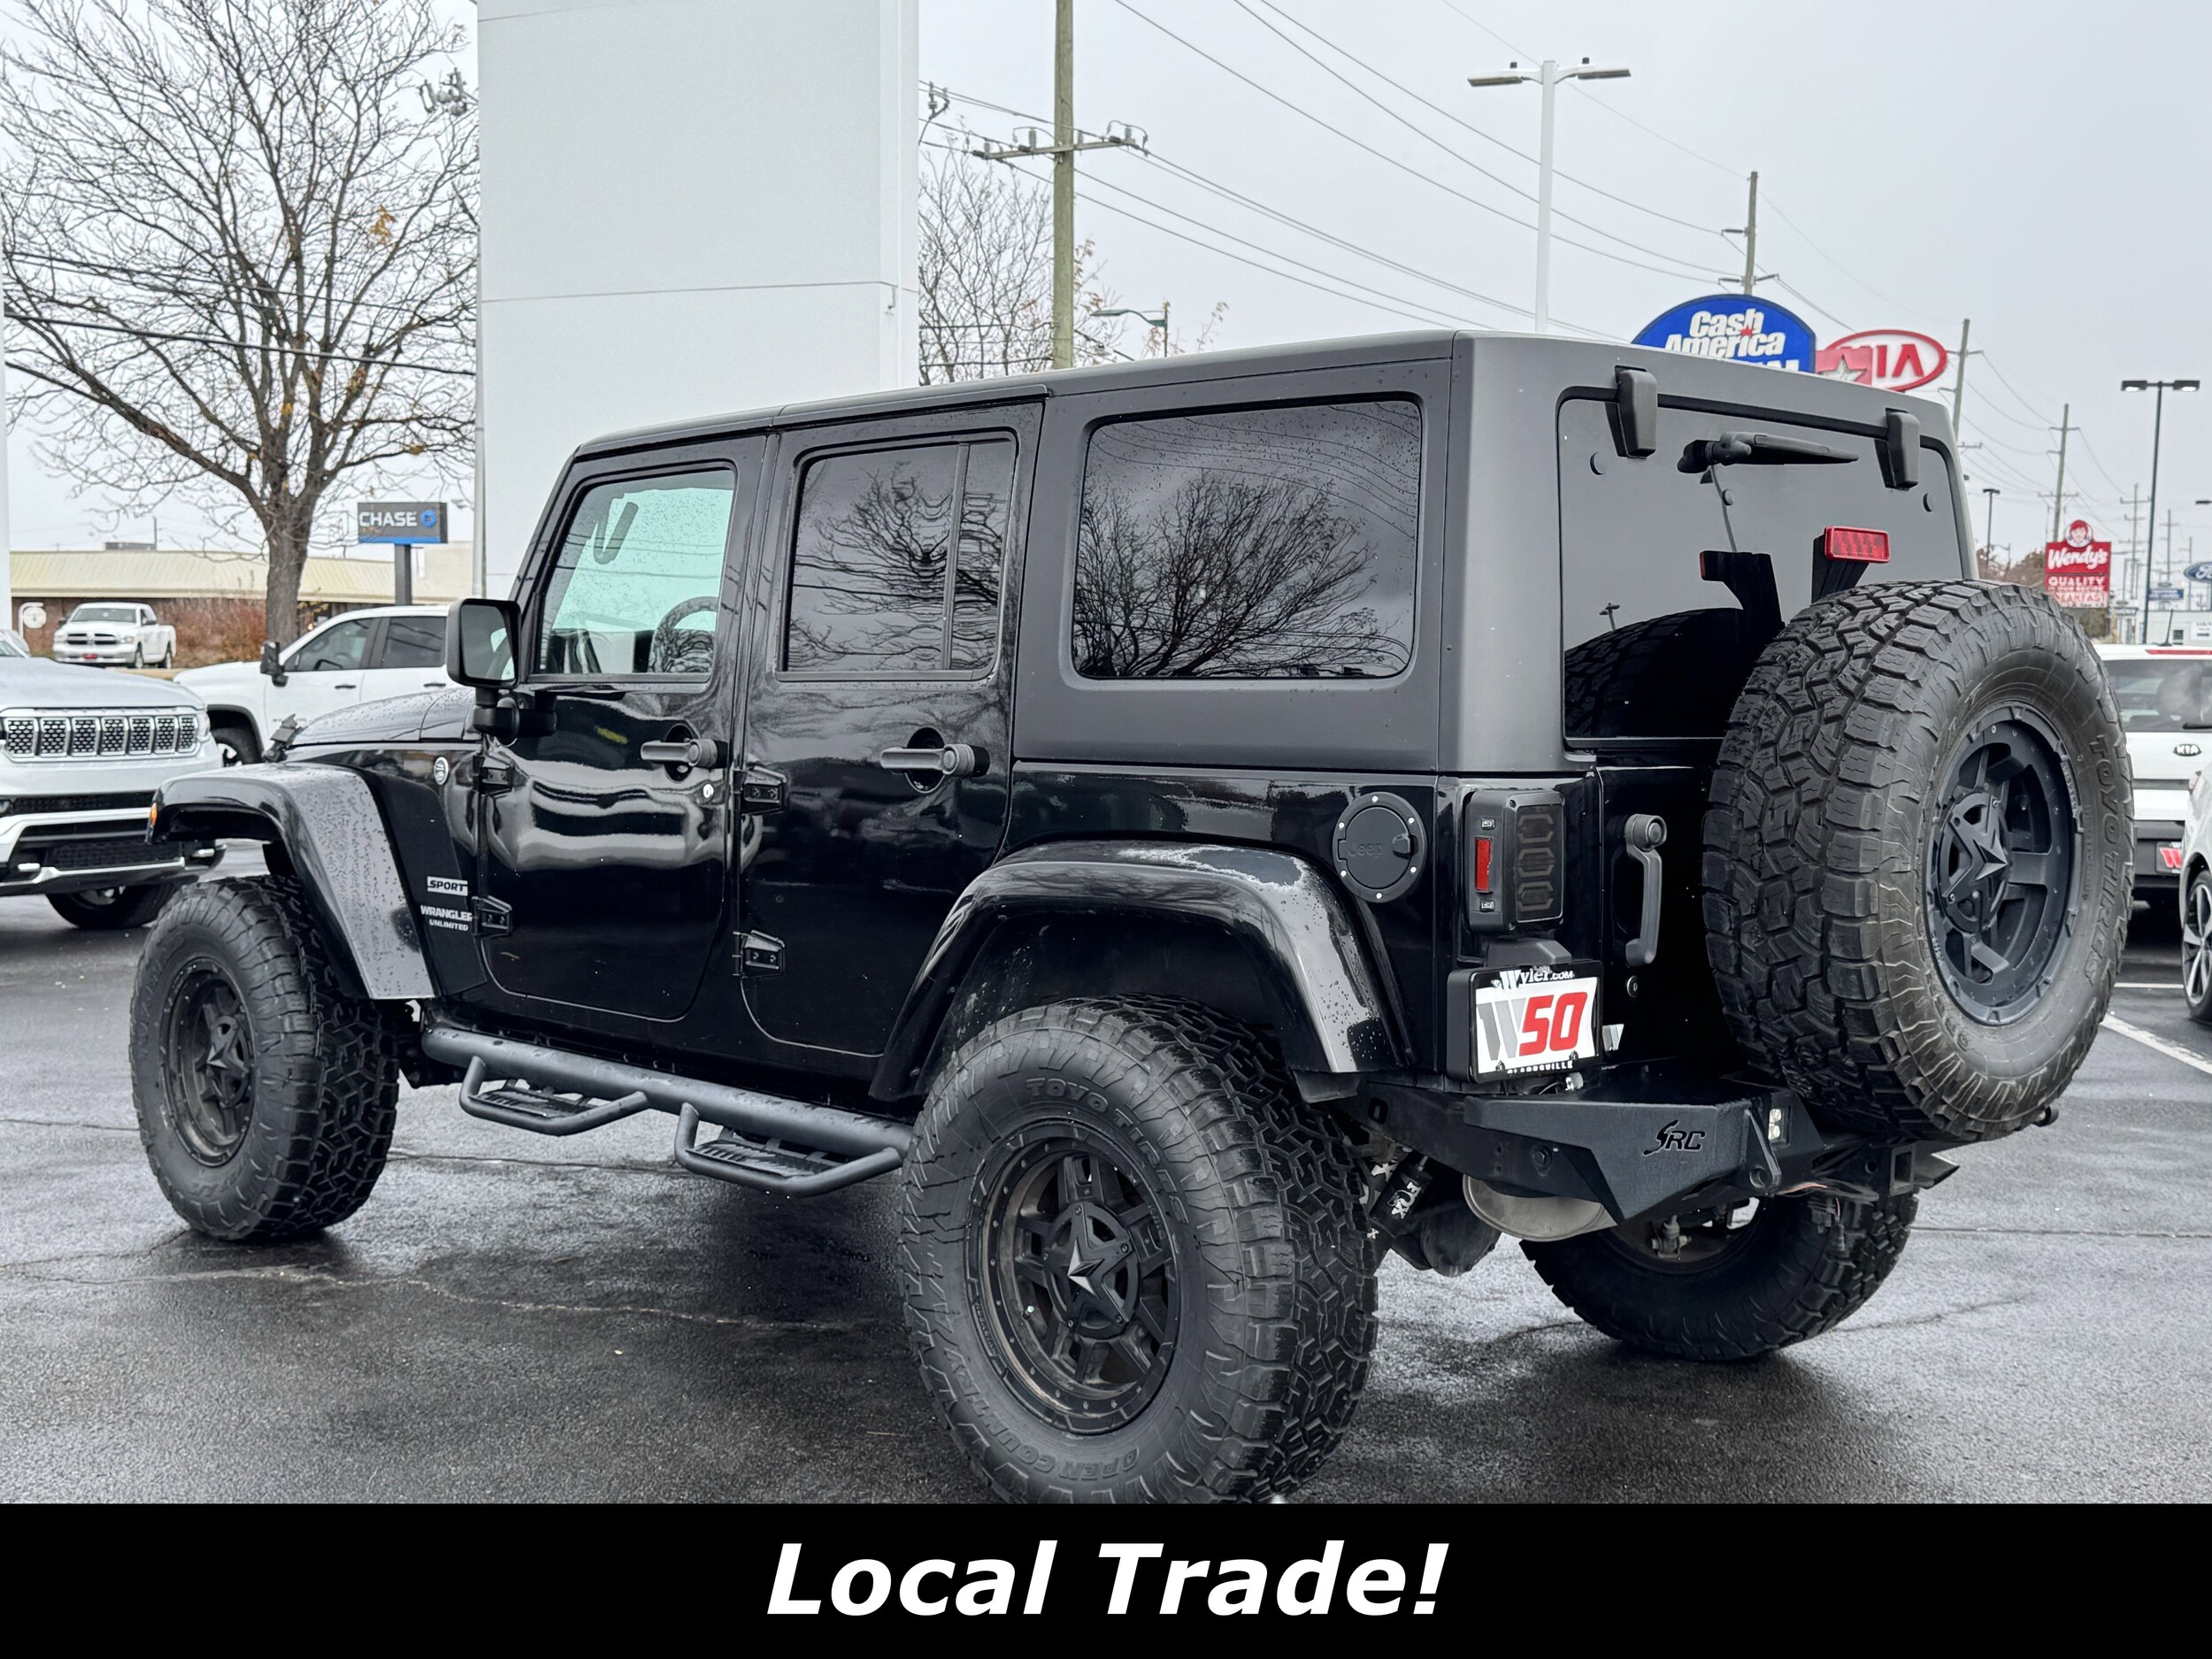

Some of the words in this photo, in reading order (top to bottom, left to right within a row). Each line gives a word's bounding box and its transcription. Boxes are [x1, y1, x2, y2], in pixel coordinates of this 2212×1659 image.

[1689, 309, 1765, 338] Cash
[1664, 331, 1786, 357] America
[358, 511, 419, 527] CHASE
[2047, 544, 2108, 570] Wendy's
[2047, 576, 2106, 587] QUALITY
[2089, 733, 2120, 845] TOYO
[428, 879, 467, 892] SPORT
[420, 904, 473, 922] WRANGLER
[429, 918, 469, 932] UNLIMITED
[1025, 1077, 1109, 1113] TOYO
[1386, 1181, 1422, 1219] FOX
[1059, 1447, 1140, 1481] OPEN
